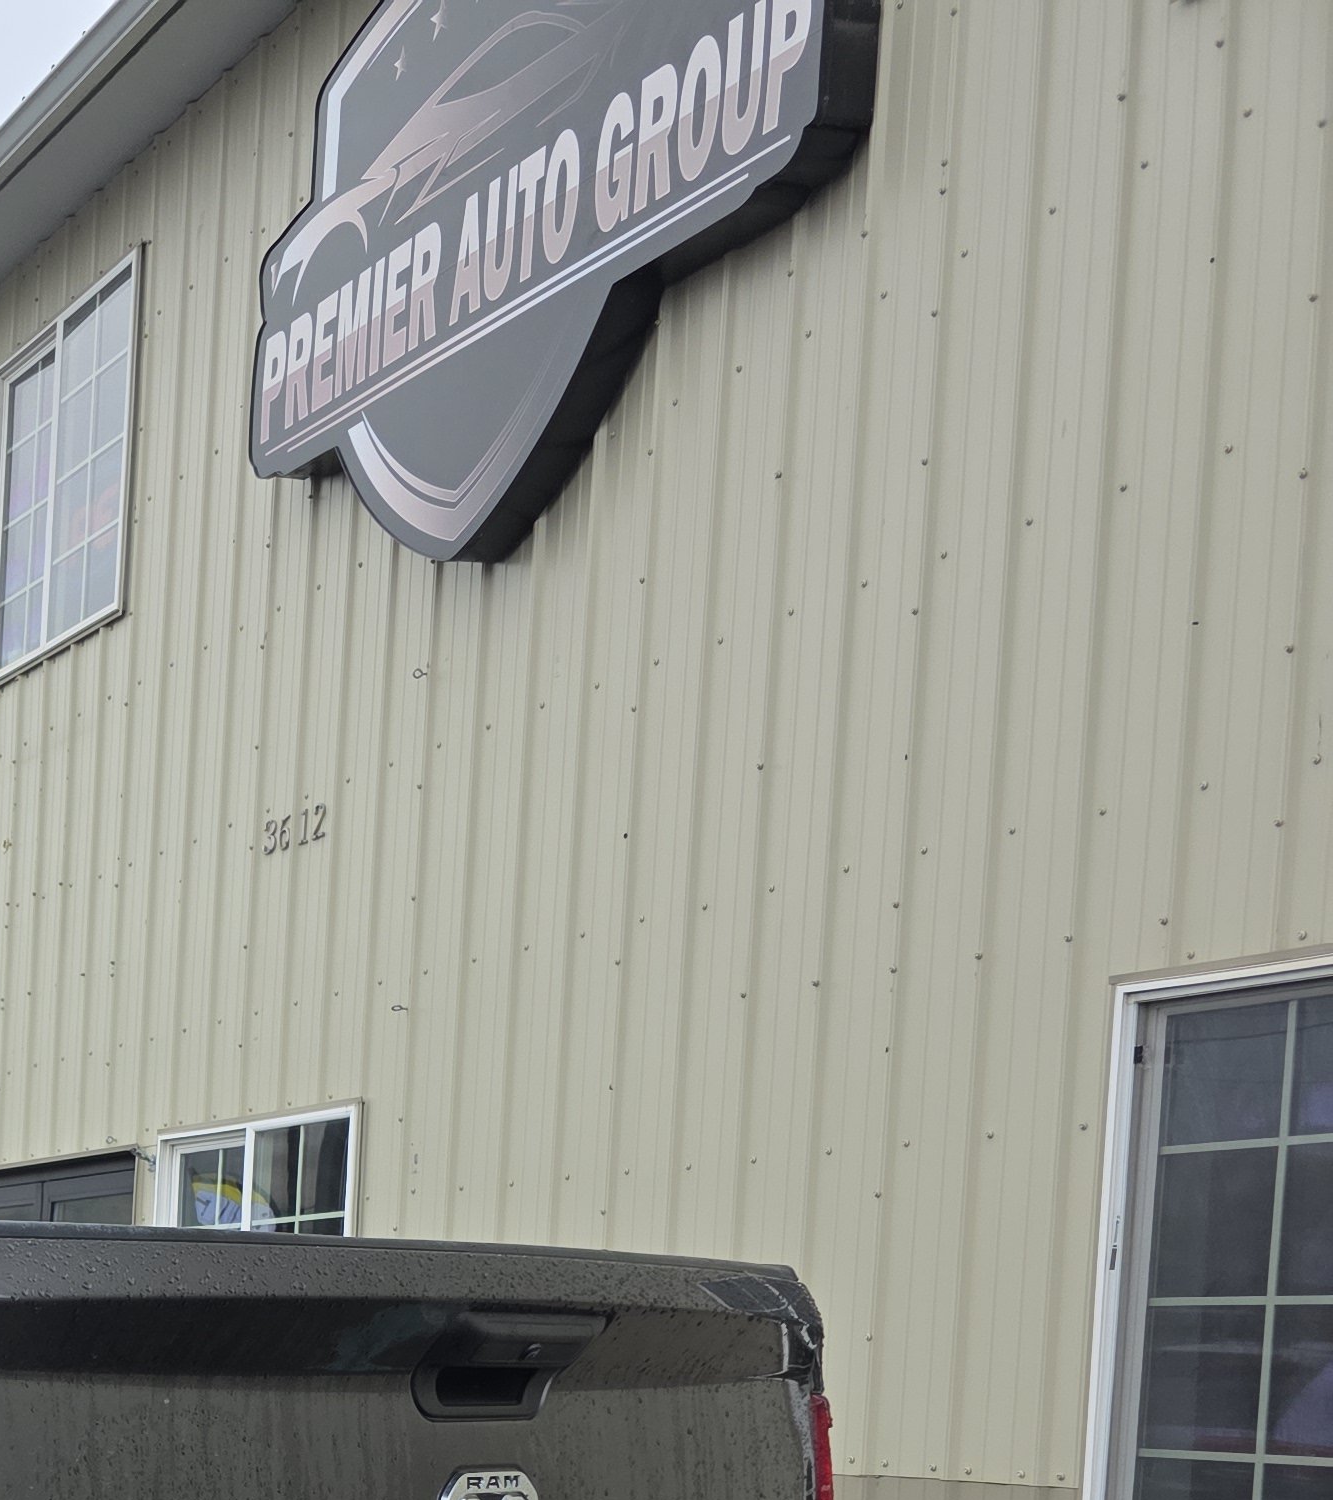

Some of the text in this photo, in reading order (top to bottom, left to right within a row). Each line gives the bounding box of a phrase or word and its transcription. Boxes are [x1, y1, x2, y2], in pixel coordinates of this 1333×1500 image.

[260, 0, 813, 445] PREMIER AUTO GROUP
[466, 1474, 522, 1490] RAM
